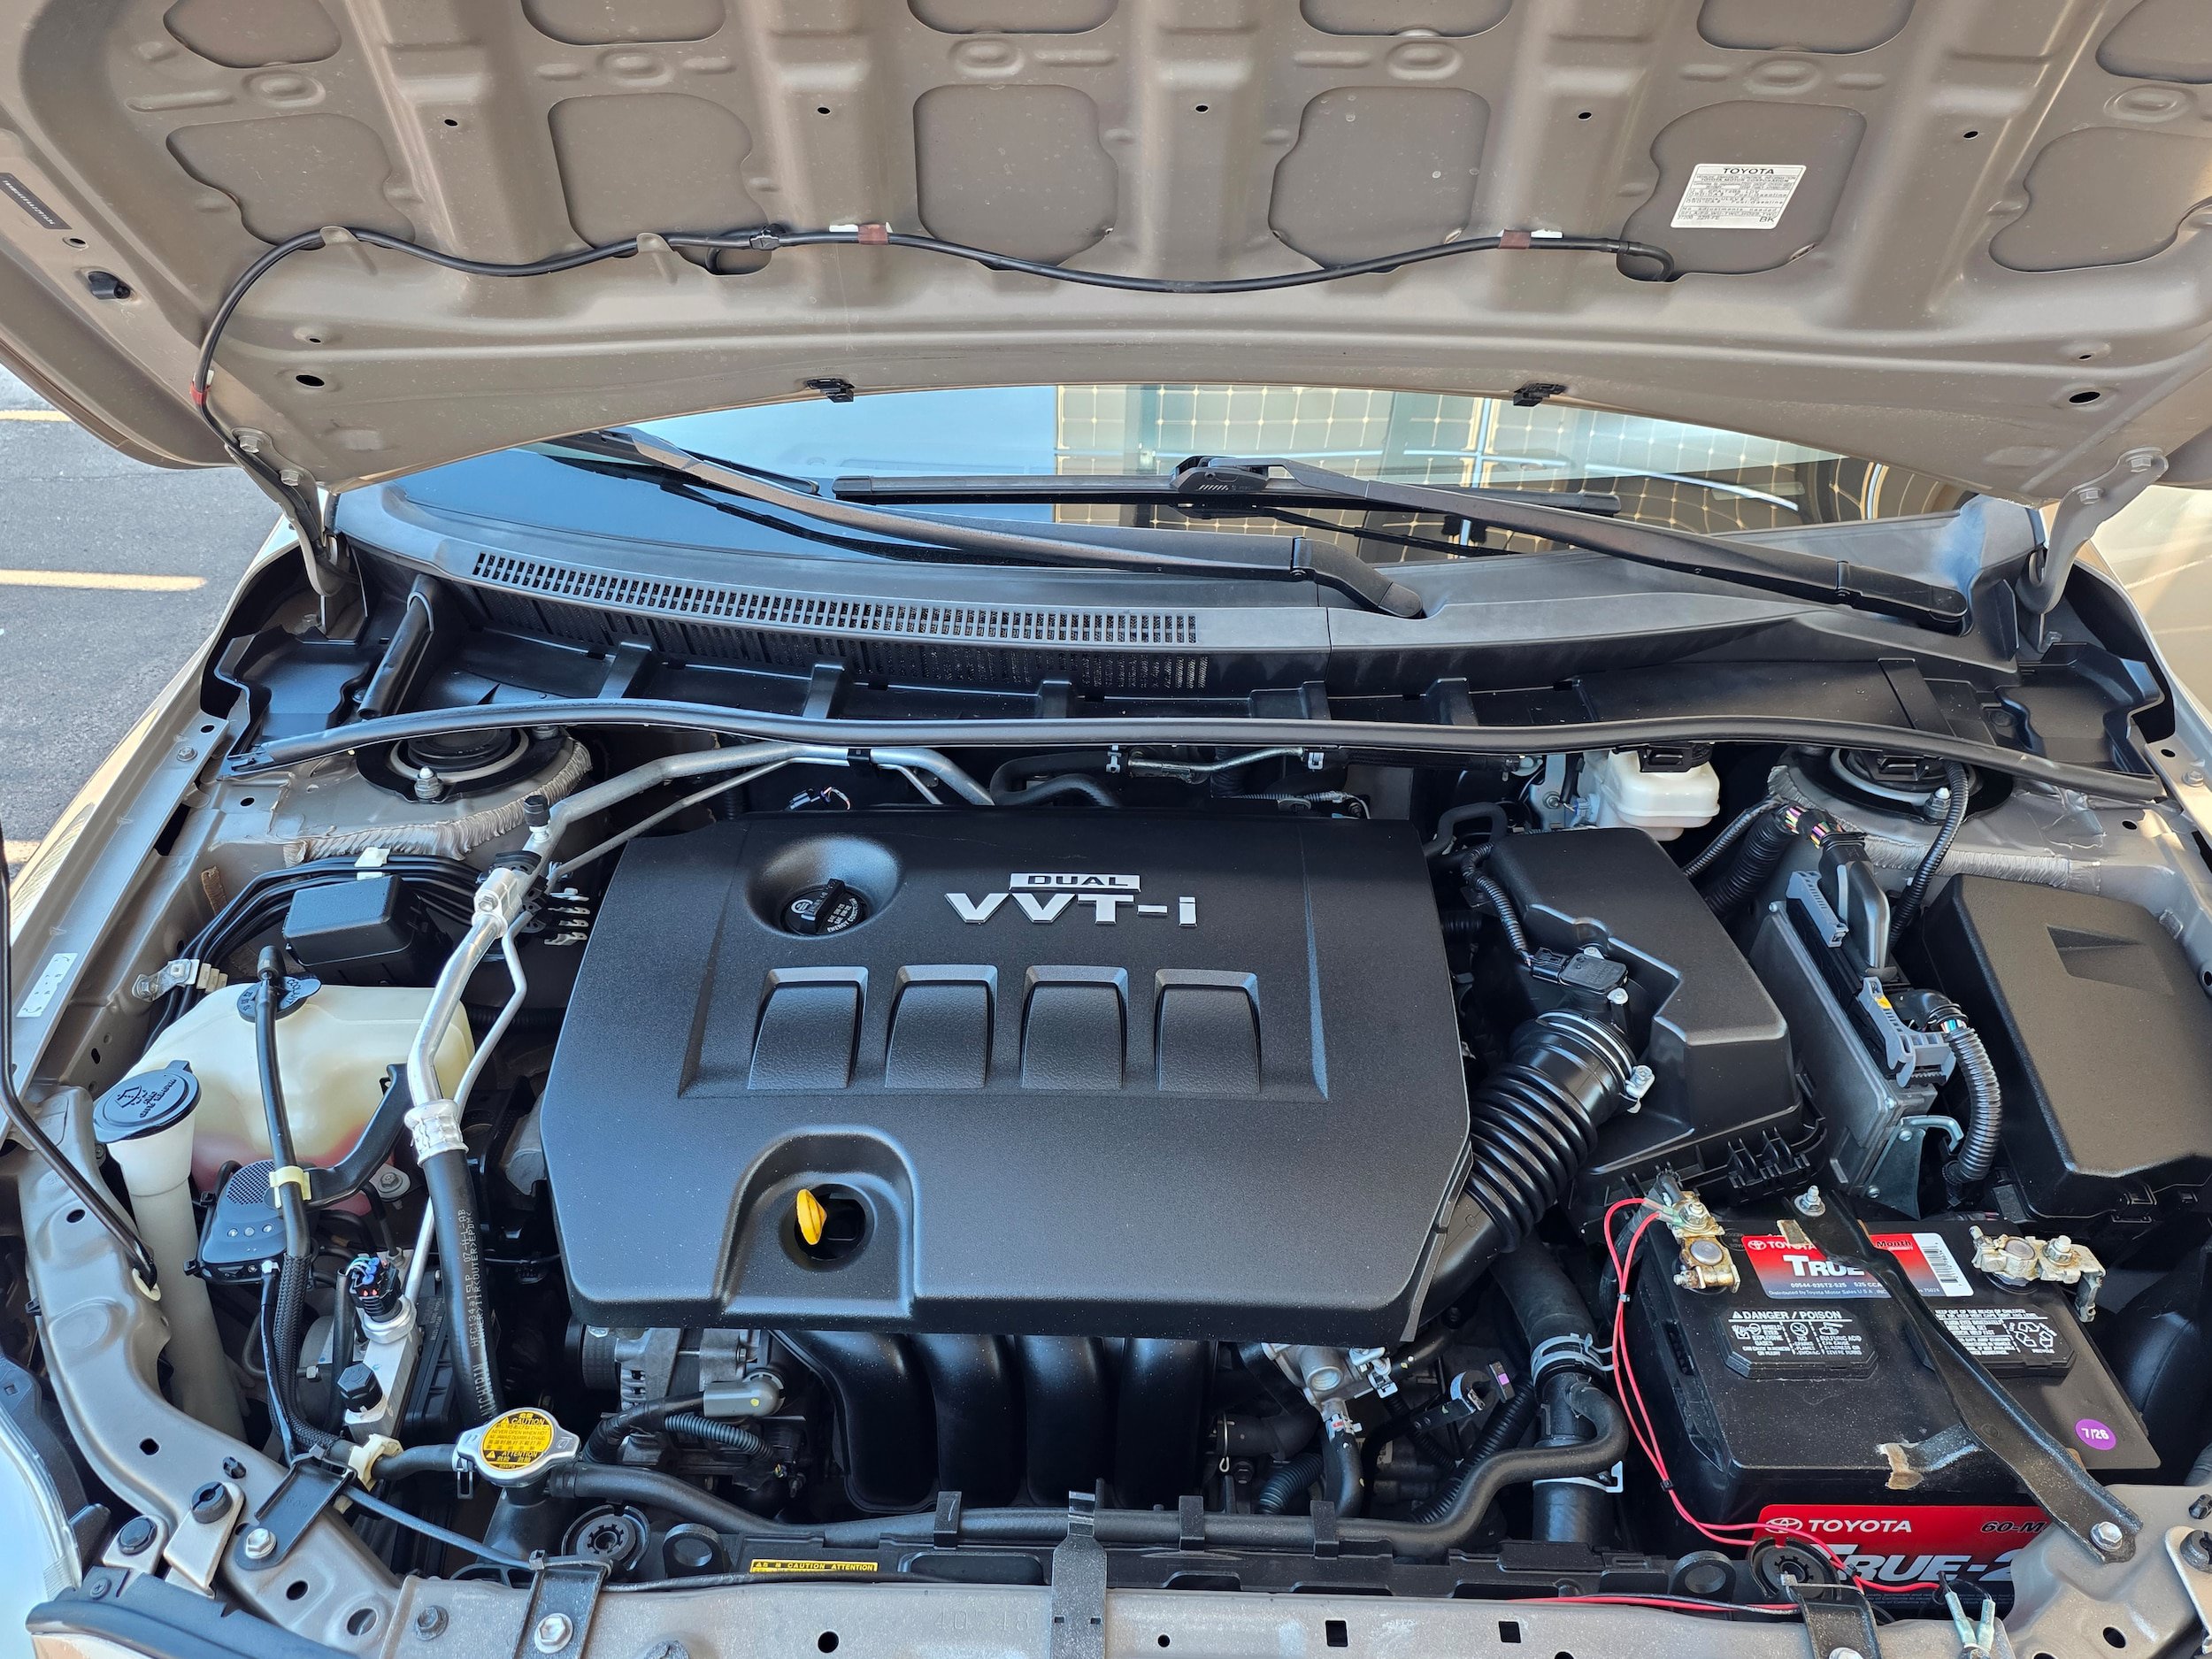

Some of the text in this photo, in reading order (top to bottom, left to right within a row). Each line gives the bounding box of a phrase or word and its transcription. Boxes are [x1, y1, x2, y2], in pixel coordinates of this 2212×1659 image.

[1028, 875, 1129, 887] DUAL
[944, 893, 1198, 926] VVT-i
[826, 920, 849, 933] ENERGY
[286, 979, 302, 1004] COOLANT
[1809, 1519, 1913, 1533] TOYOTA
